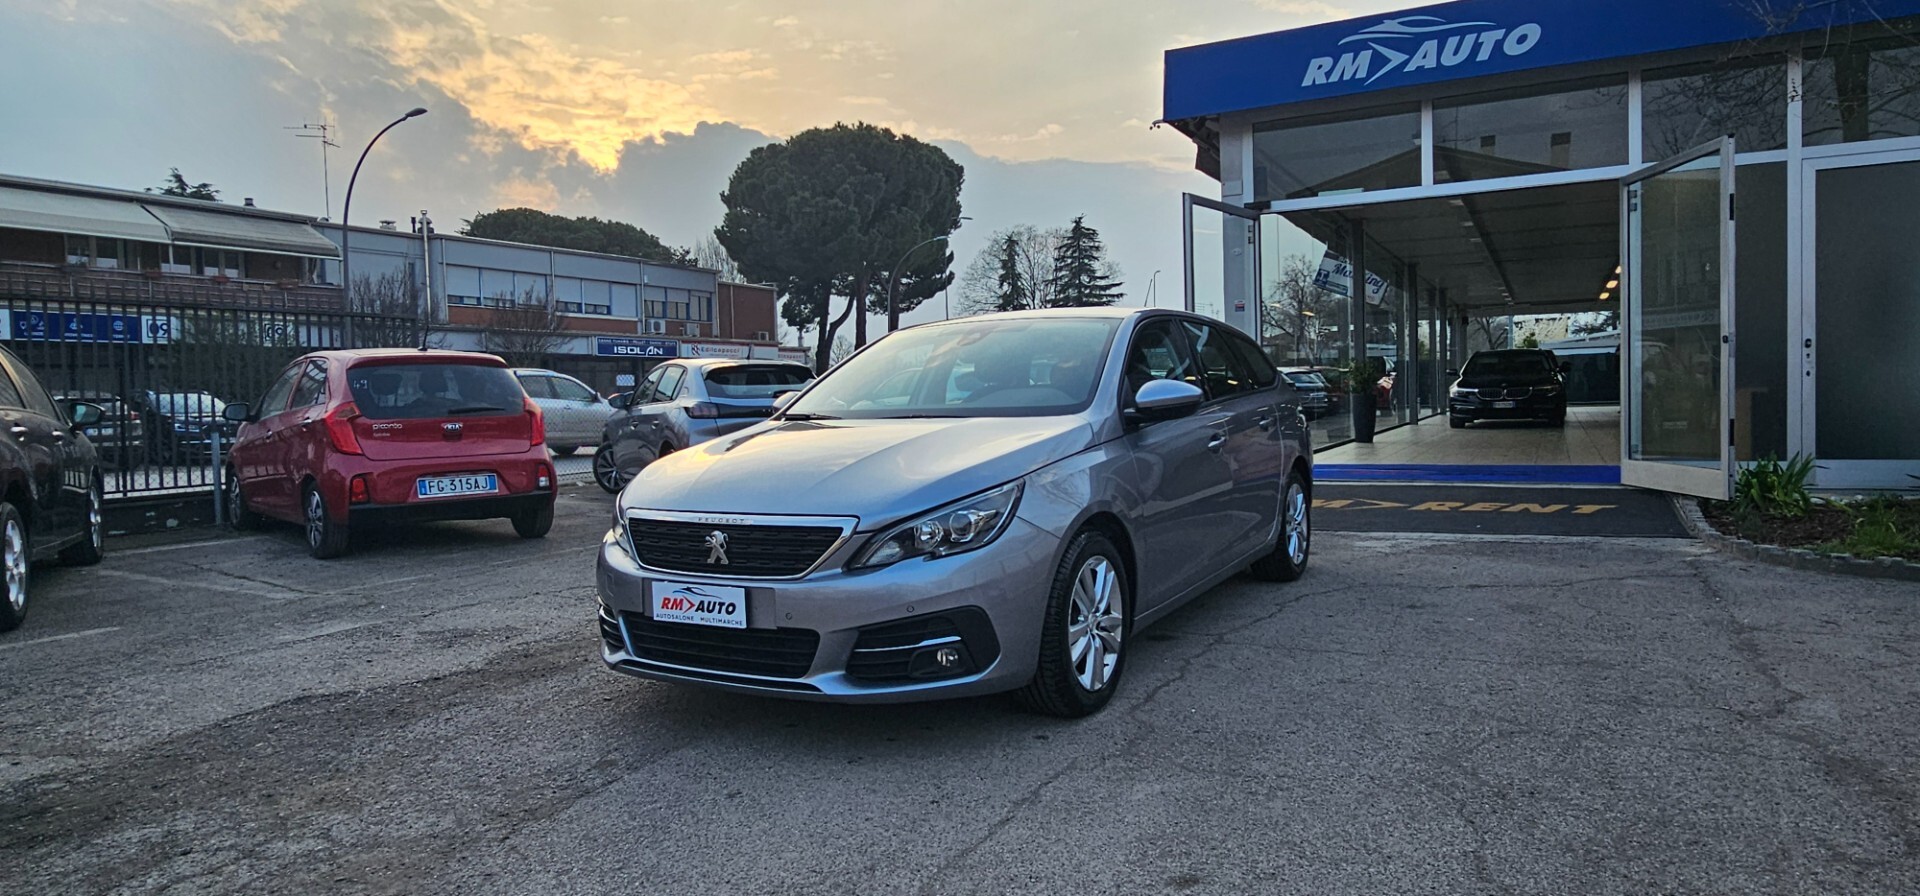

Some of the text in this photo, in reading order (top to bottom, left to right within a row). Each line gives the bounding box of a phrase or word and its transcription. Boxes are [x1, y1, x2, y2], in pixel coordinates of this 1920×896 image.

[1301, 23, 1542, 87] RM AUTO
[614, 346, 663, 356] ISOLAN
[1407, 501, 1619, 514] RENT
[661, 597, 736, 615] RM AUTO
[656, 613, 743, 626] AUTOSALONE MULTIMARCHE
